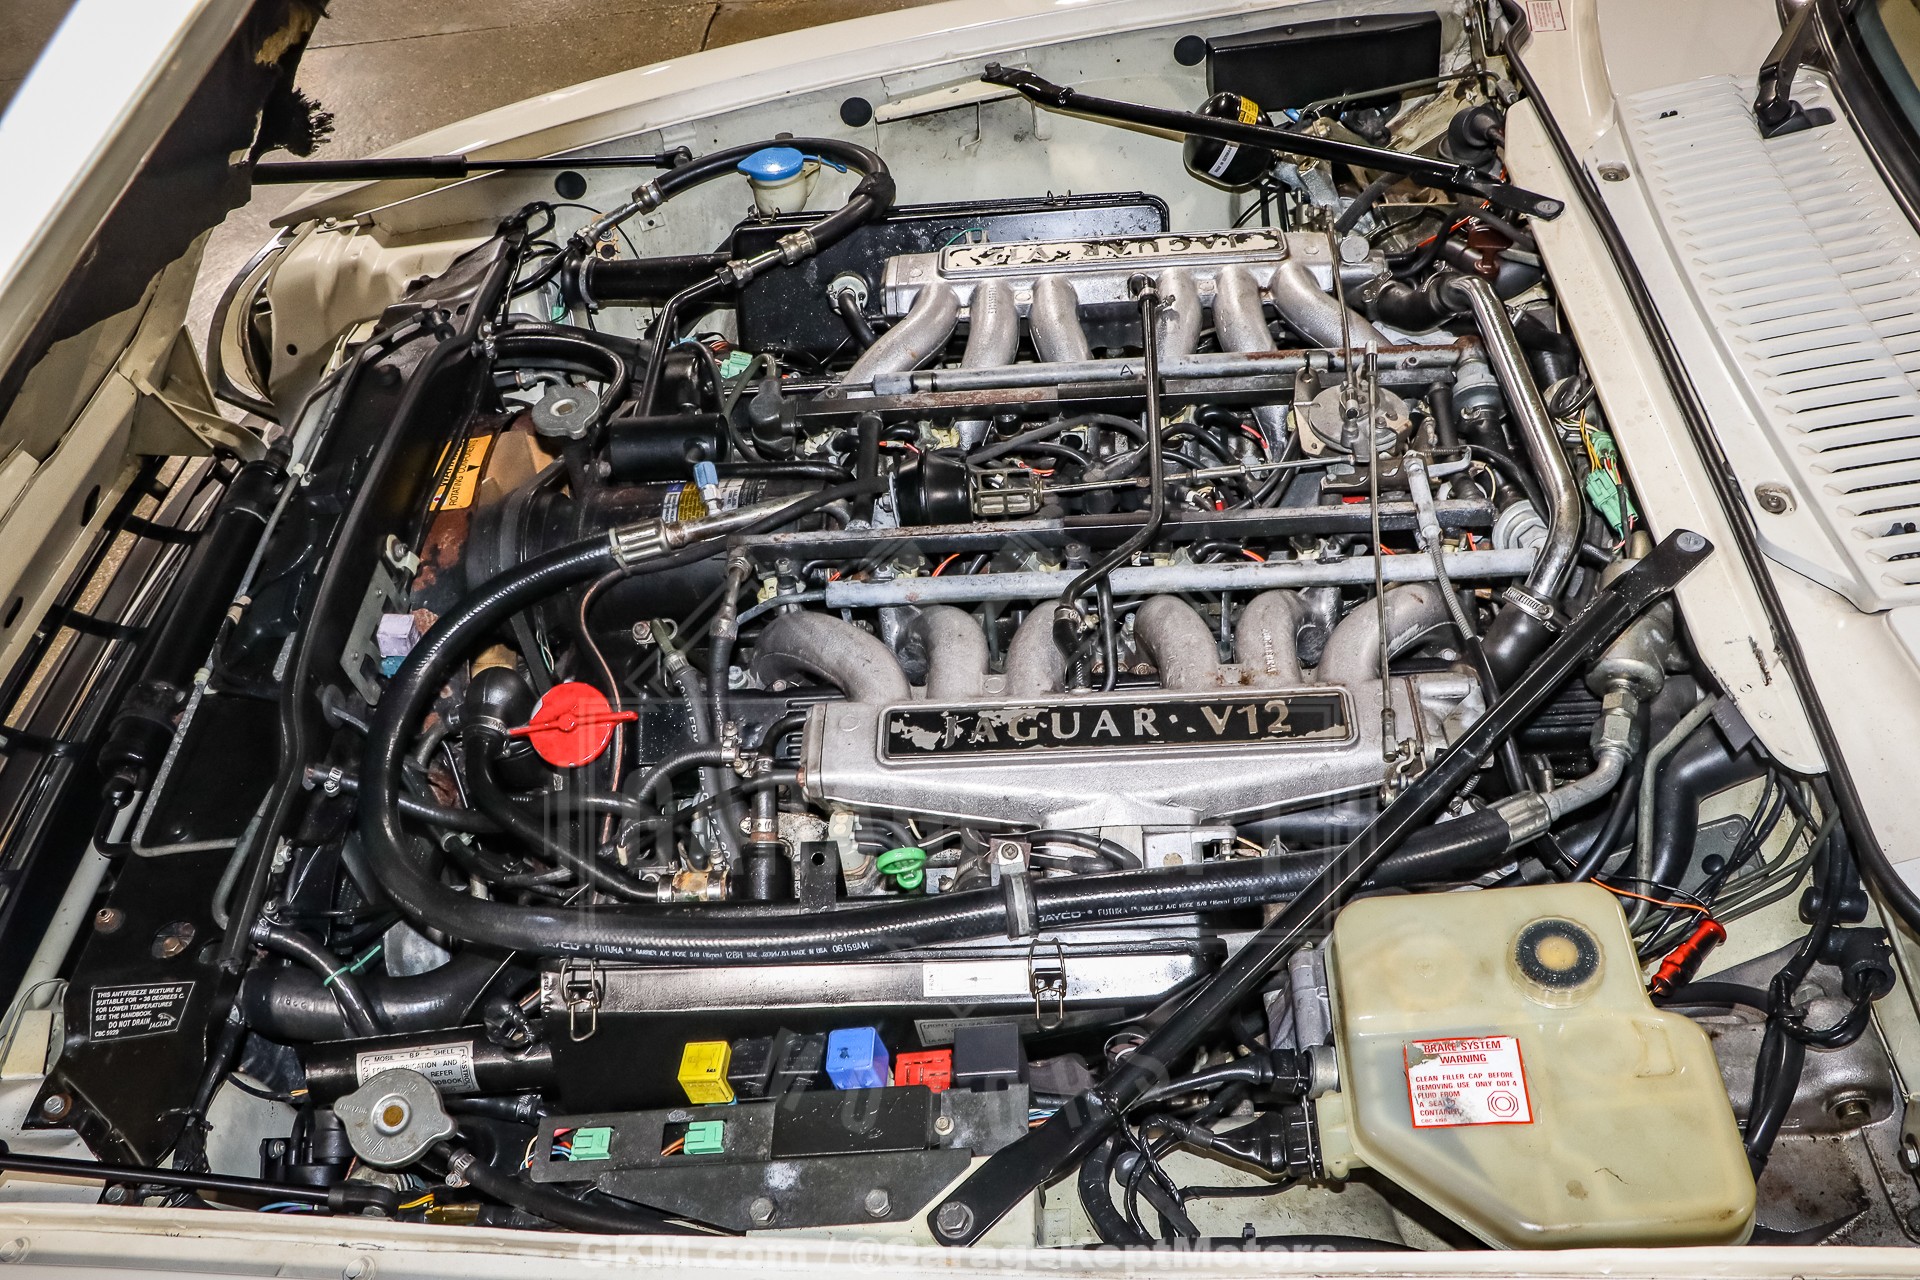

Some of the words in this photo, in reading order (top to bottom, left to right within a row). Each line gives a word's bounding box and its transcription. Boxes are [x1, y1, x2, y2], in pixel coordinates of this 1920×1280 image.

[1120, 364, 1133, 376] A
[942, 708, 1160, 749] JAGUAR
[1201, 700, 1292, 736] V12
[594, 945, 624, 954] FUTURA
[112, 989, 148, 997] ANTIFREEZE
[130, 1001, 173, 1010] TEMPERATURES
[132, 1018, 151, 1027] DRAIN
[148, 1020, 172, 1030] JAGUAR
[1424, 1042, 1457, 1053] BRAKE
[1461, 1041, 1501, 1050] SYSTEM
[1440, 1054, 1487, 1064] WARNING
[462, 1054, 471, 1085] CASTROL
